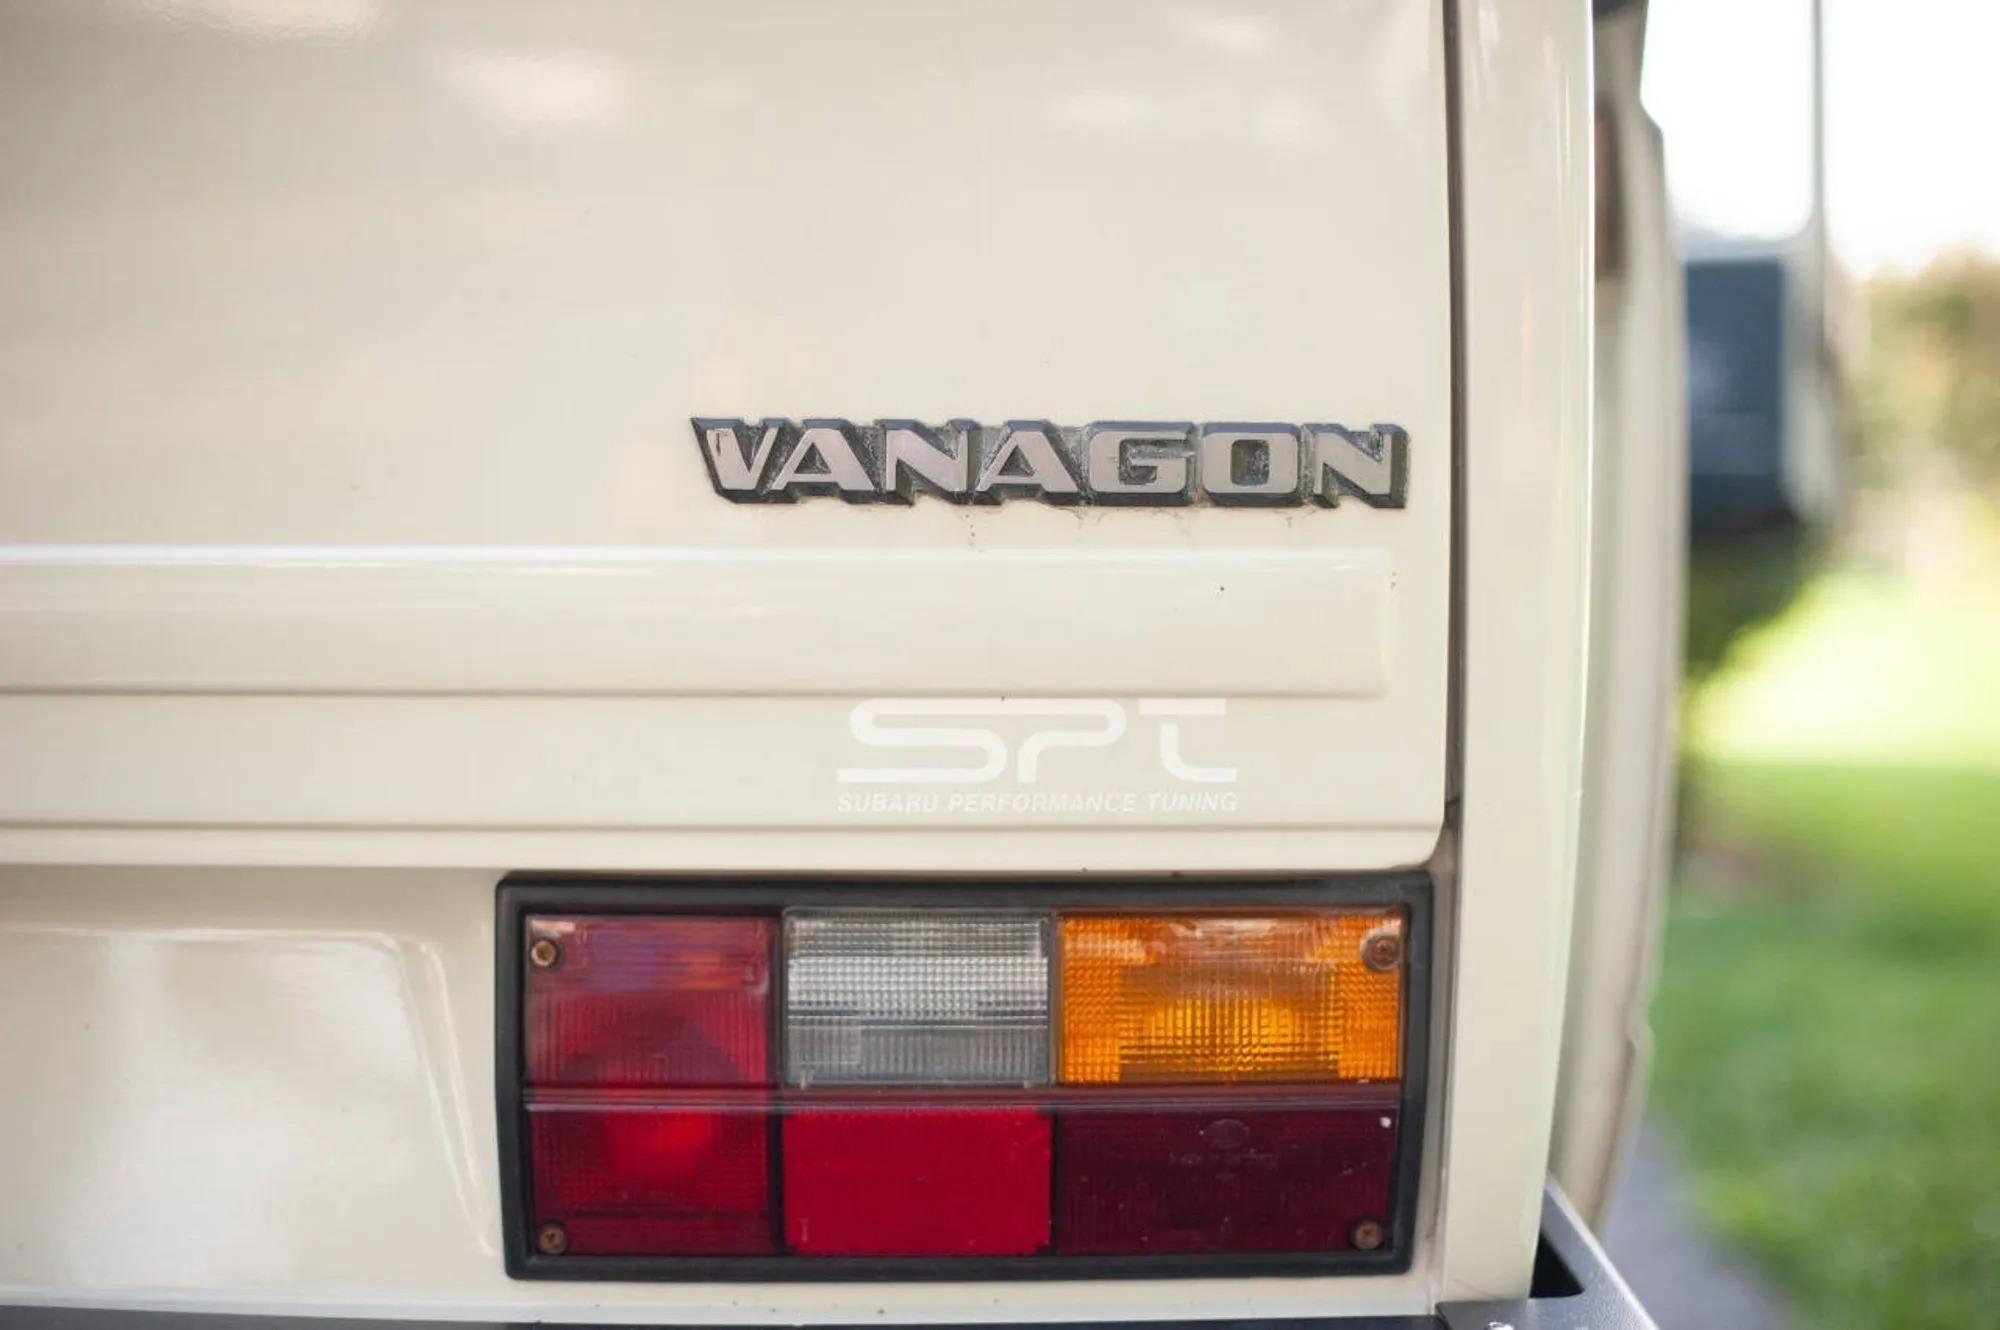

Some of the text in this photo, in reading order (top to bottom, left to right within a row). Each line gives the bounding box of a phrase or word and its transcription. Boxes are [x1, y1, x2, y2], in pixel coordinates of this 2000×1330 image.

[692, 417, 1407, 509] VANAGON
[837, 698, 1238, 783] SPT
[837, 793, 1238, 813] SUBARU PERFORMANCE TUNING
